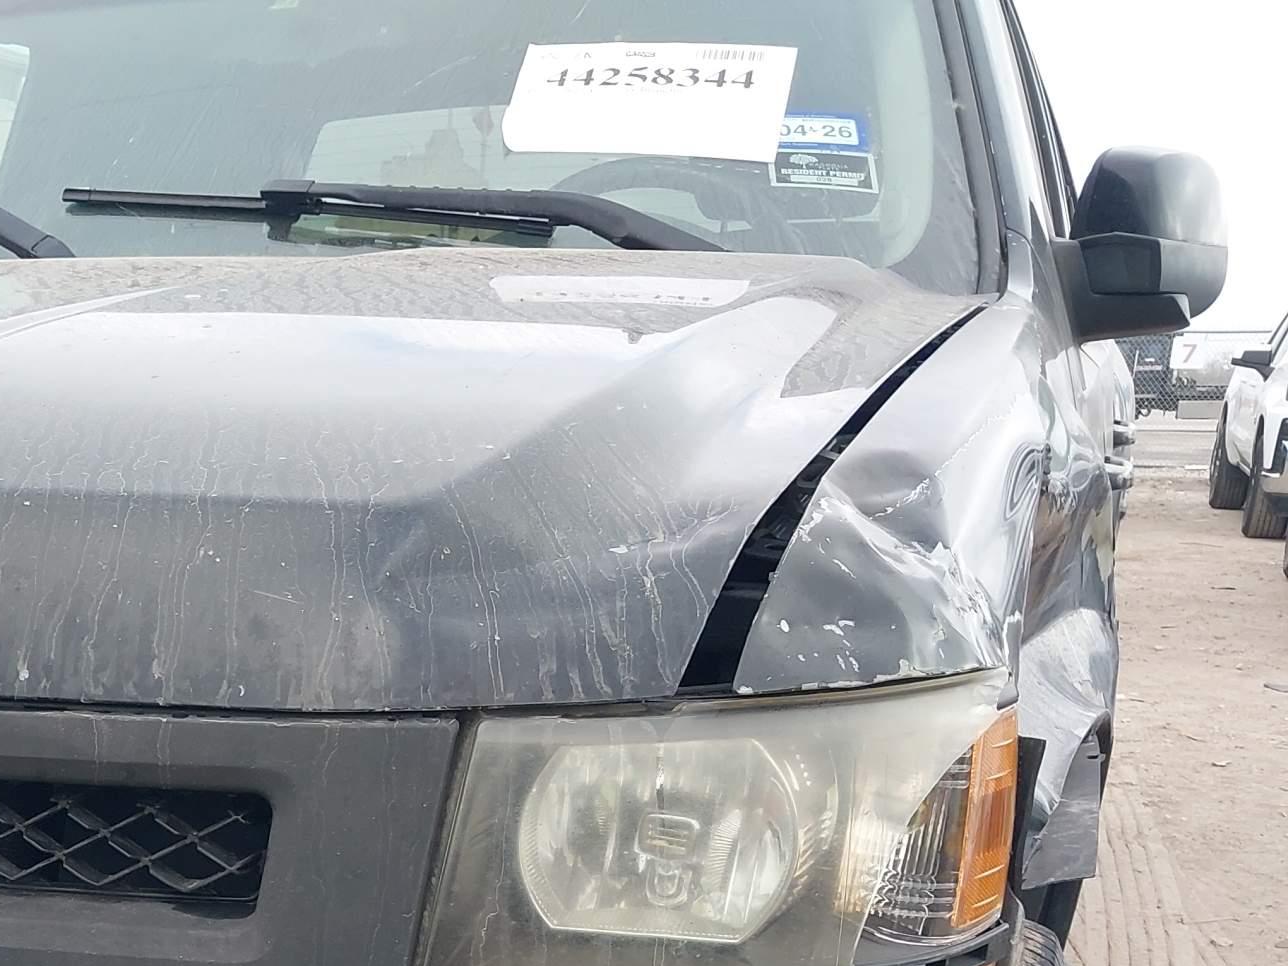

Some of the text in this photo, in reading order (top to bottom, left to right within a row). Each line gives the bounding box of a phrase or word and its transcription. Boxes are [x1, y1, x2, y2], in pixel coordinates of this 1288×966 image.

[546, 66, 755, 88] 44258344
[779, 124, 853, 138] 04 26
[1182, 343, 1198, 364] 7
